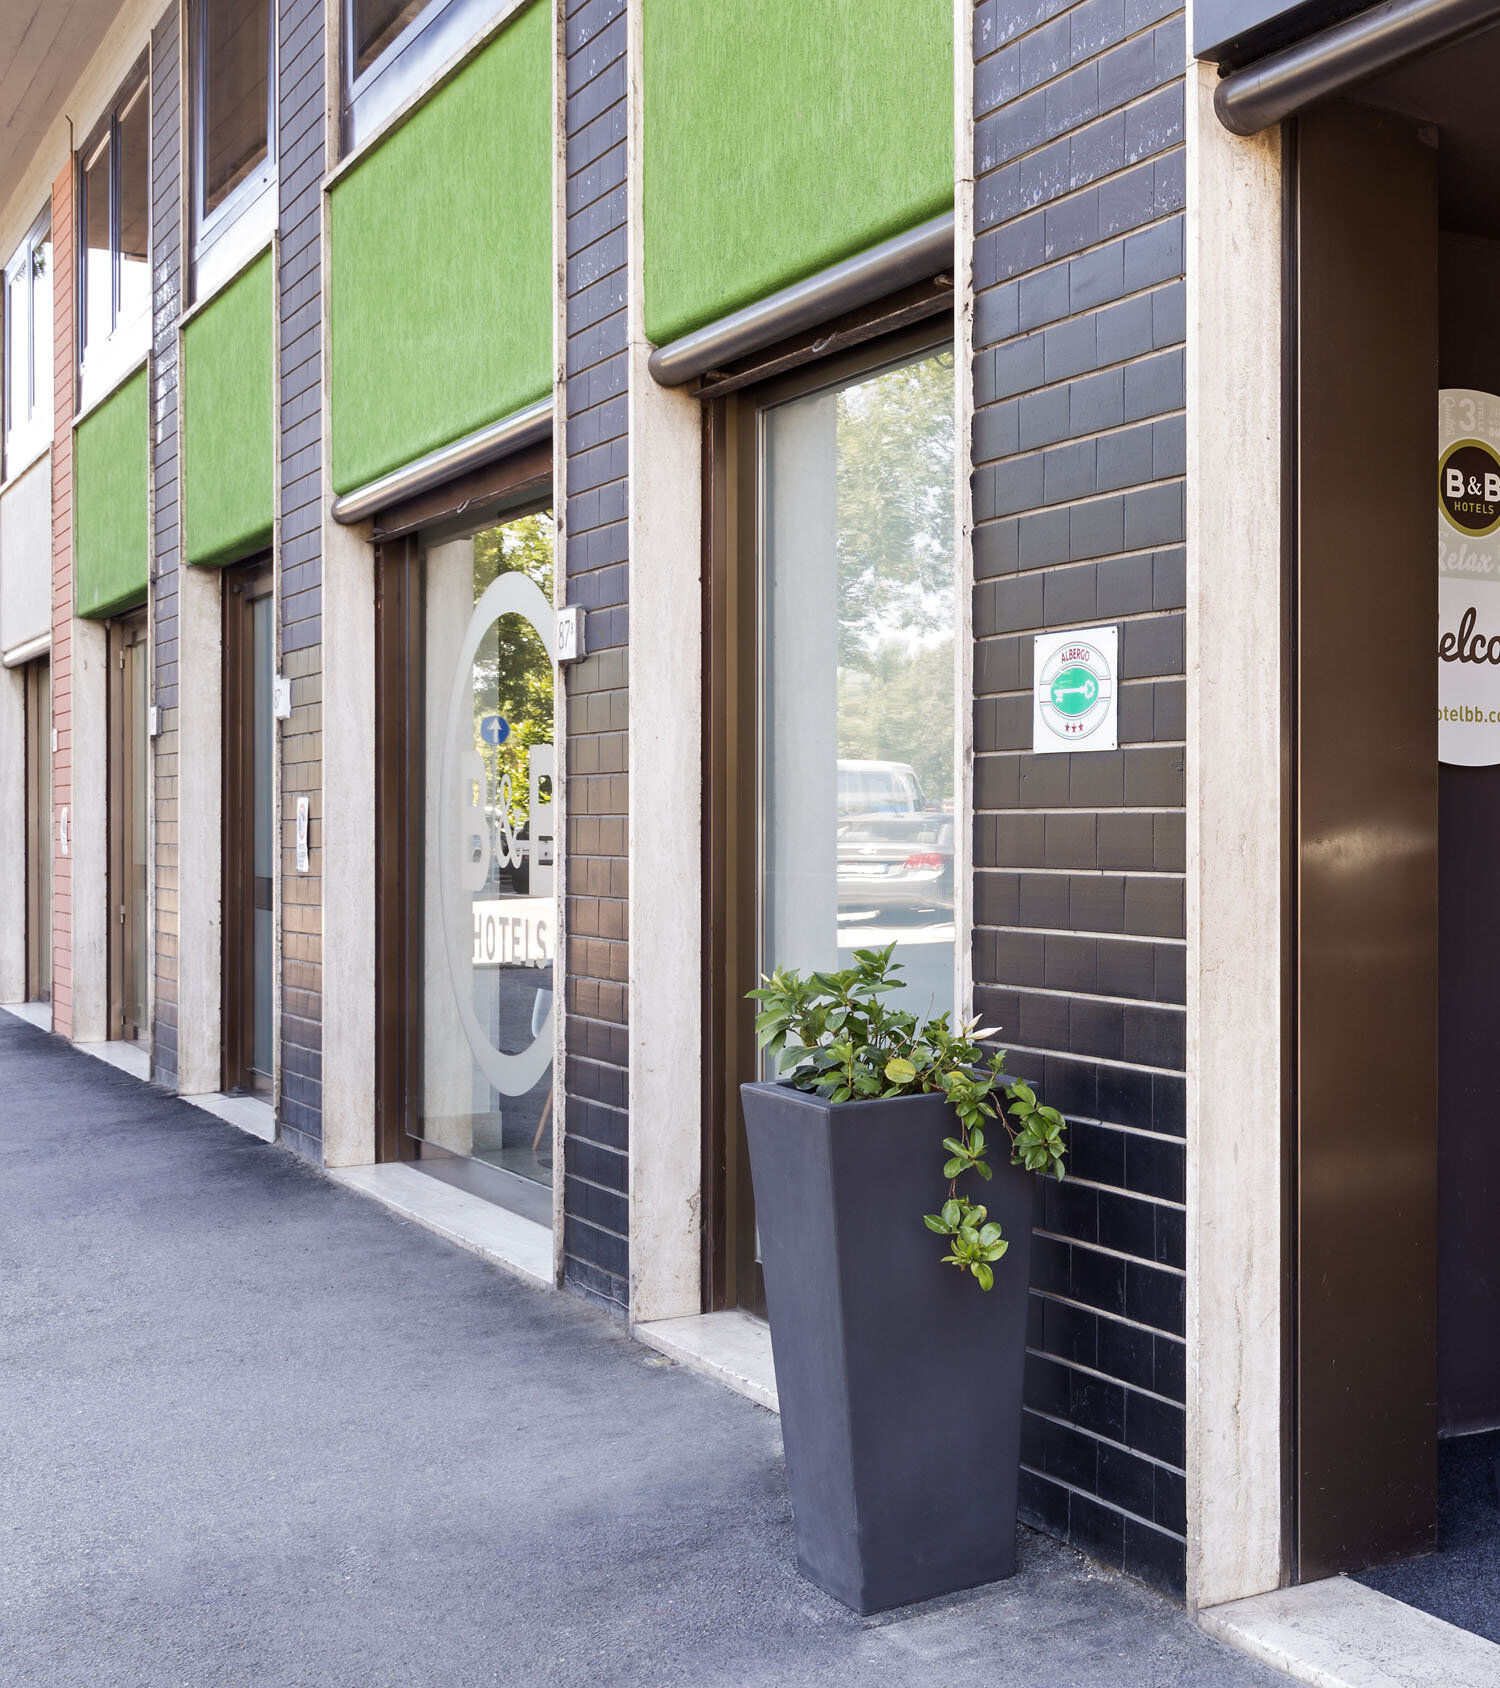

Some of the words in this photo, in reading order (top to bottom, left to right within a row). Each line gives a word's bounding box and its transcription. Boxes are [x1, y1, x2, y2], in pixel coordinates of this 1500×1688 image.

[1460, 398, 1476, 431] 3
[1454, 501, 1494, 515] HOTELS
[1061, 648, 1091, 665] ALBERGO
[461, 743, 554, 896] B&B
[472, 912, 549, 970] HOTELS
